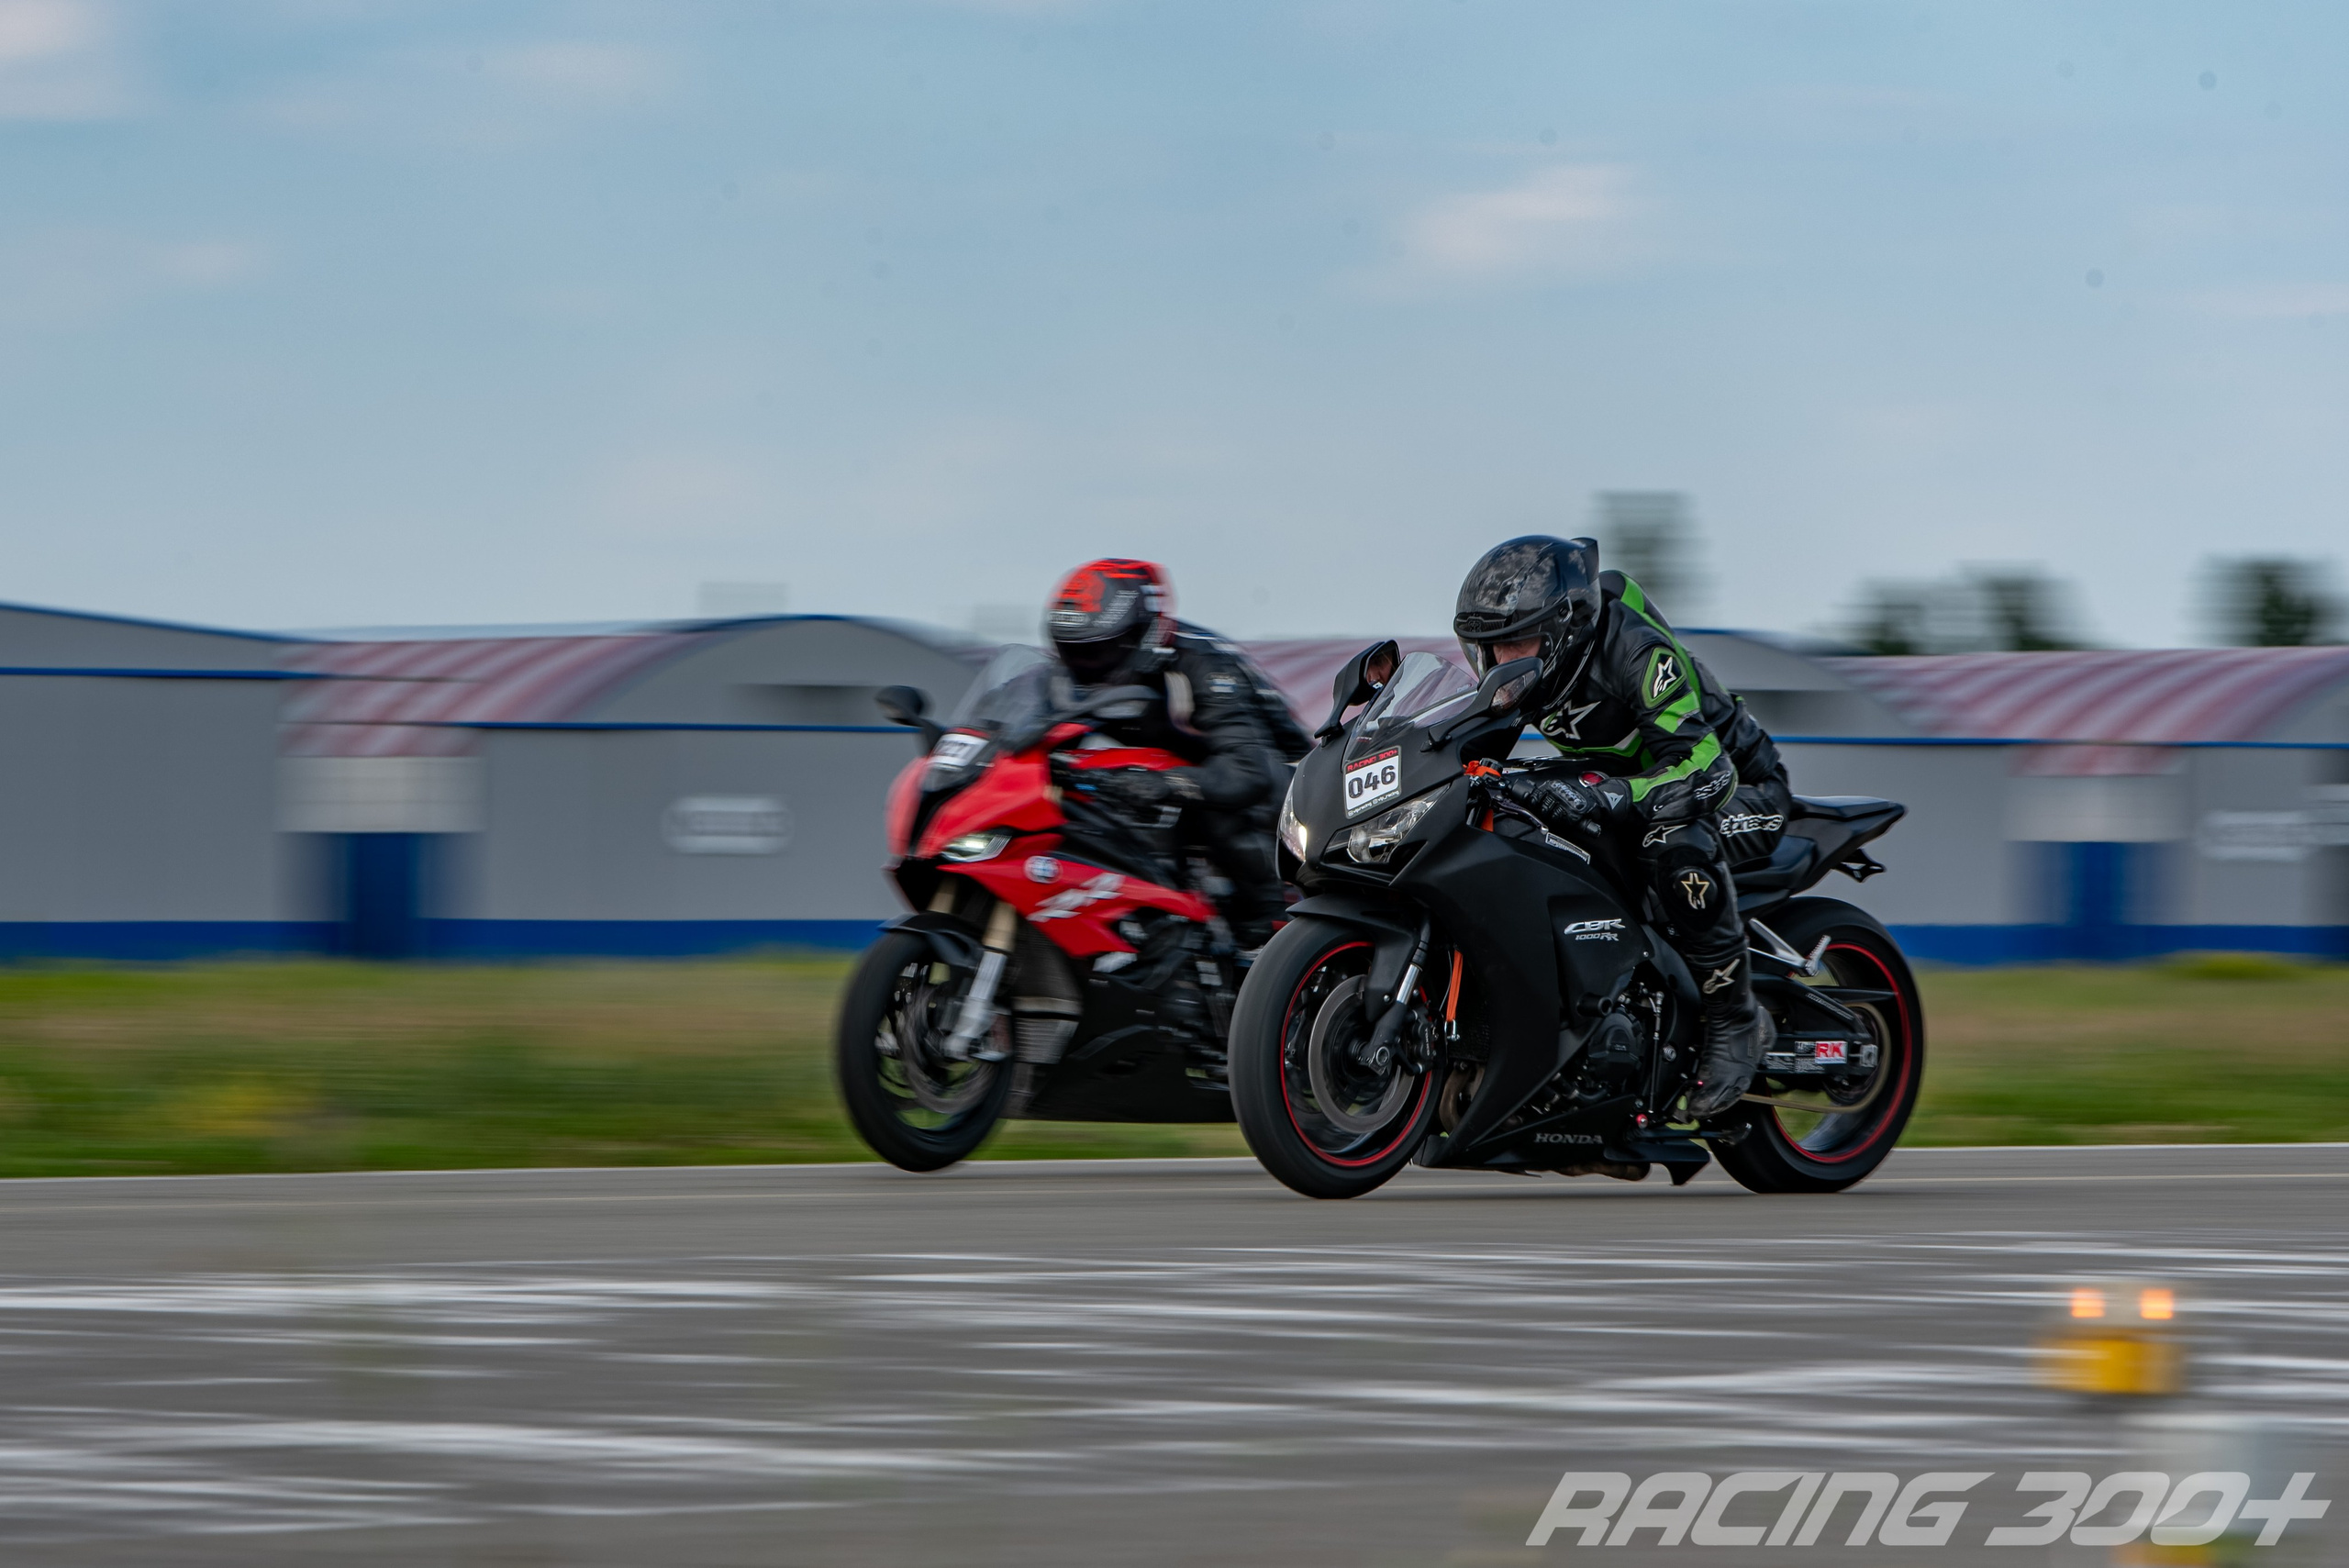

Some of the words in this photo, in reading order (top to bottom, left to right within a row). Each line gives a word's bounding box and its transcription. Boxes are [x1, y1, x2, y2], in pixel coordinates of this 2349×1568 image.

[1348, 757, 1376, 771] RACING
[1378, 750, 1397, 760] 300+
[1348, 765, 1396, 798] 046
[1564, 918, 1626, 935] CBR
[1575, 932, 1620, 941] 1000RR
[1816, 1042, 1844, 1058] RK
[1534, 1133, 1604, 1144] HONDA
